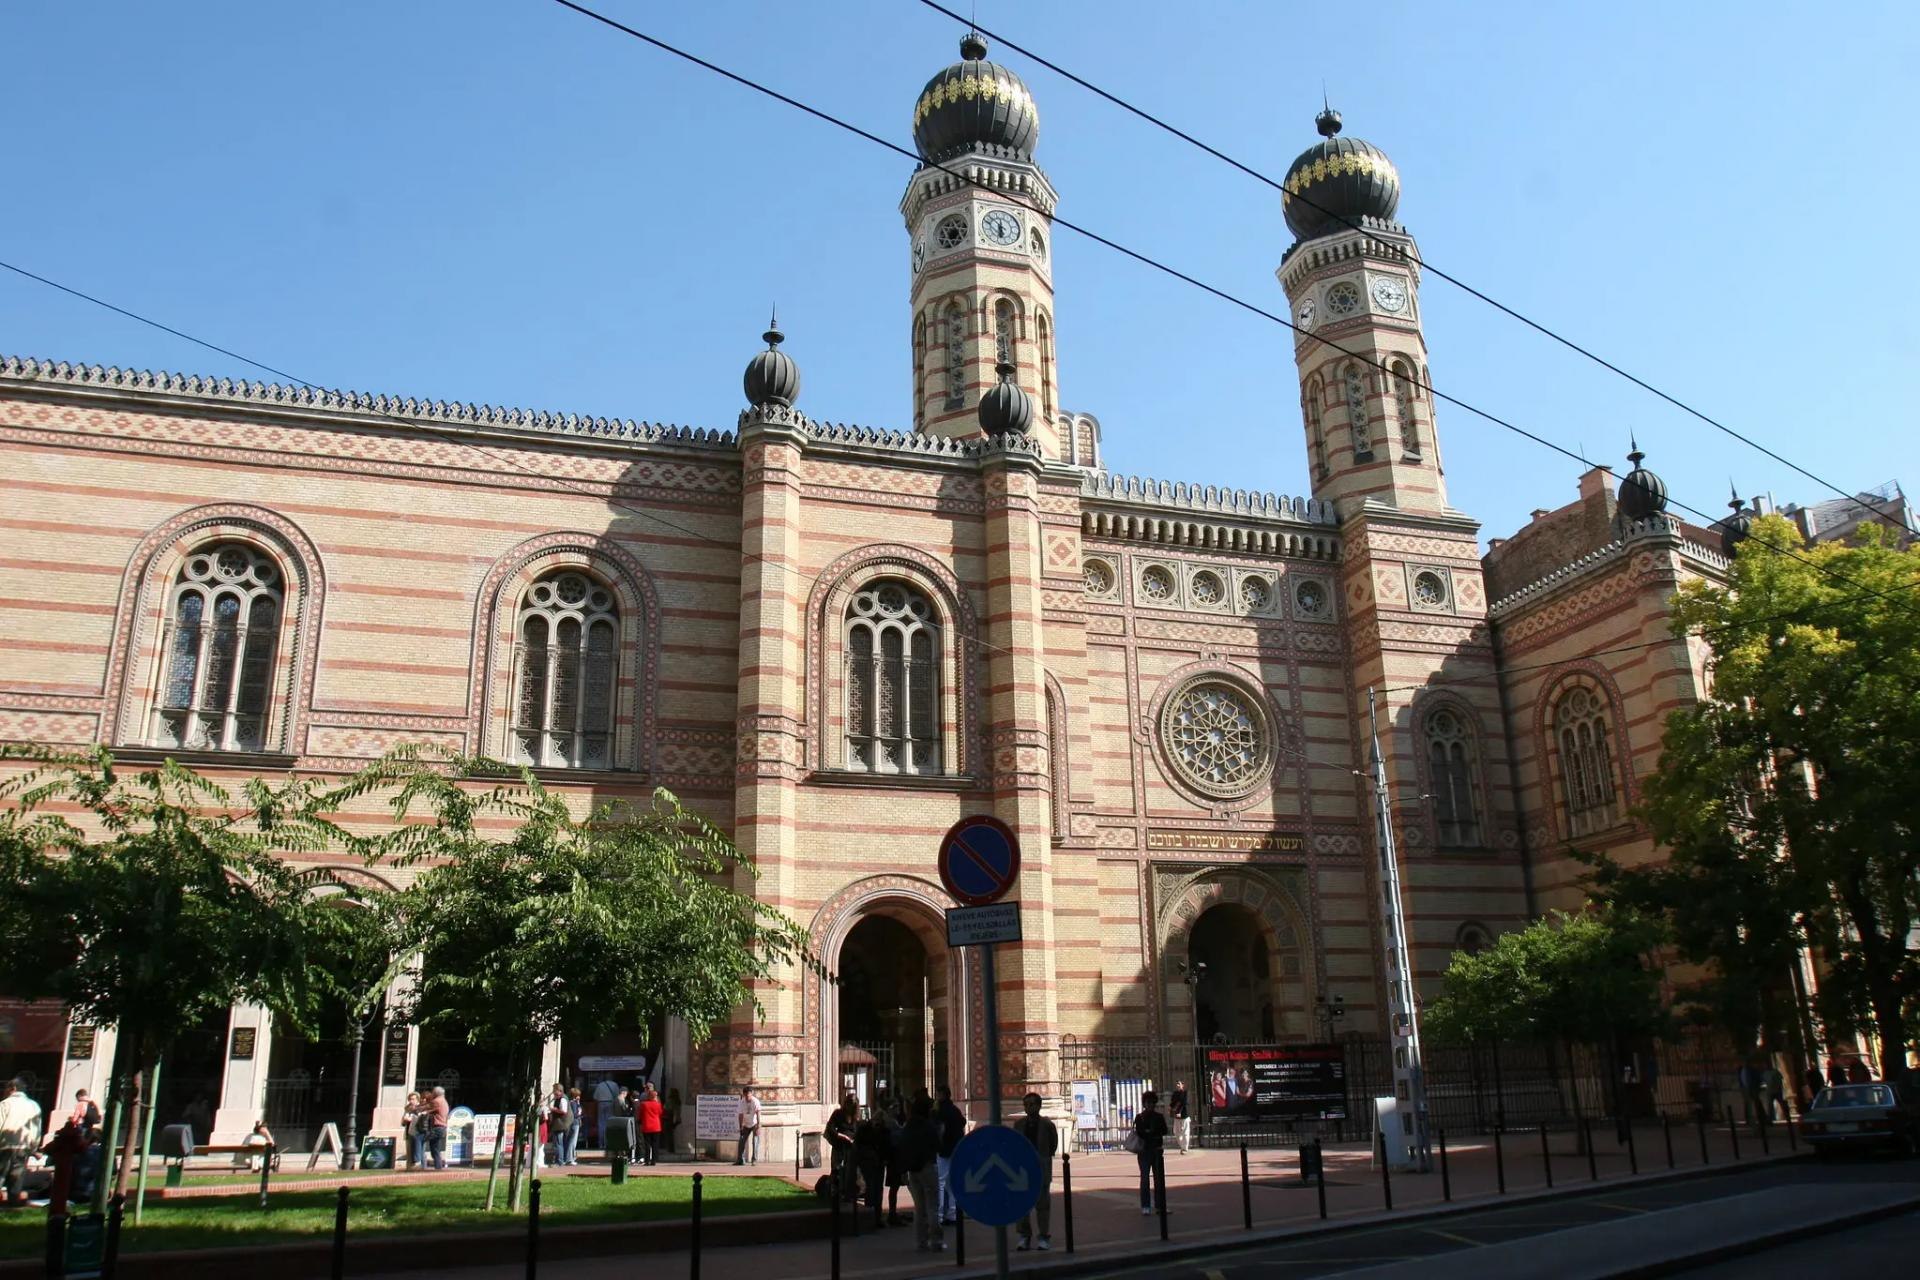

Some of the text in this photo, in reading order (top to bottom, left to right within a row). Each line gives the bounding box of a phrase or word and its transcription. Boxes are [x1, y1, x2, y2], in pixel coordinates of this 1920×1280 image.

[1149, 833, 1183, 847] בתוכם
[1185, 834, 1225, 849] ושכנתי
[1227, 836, 1262, 849] מקדש
